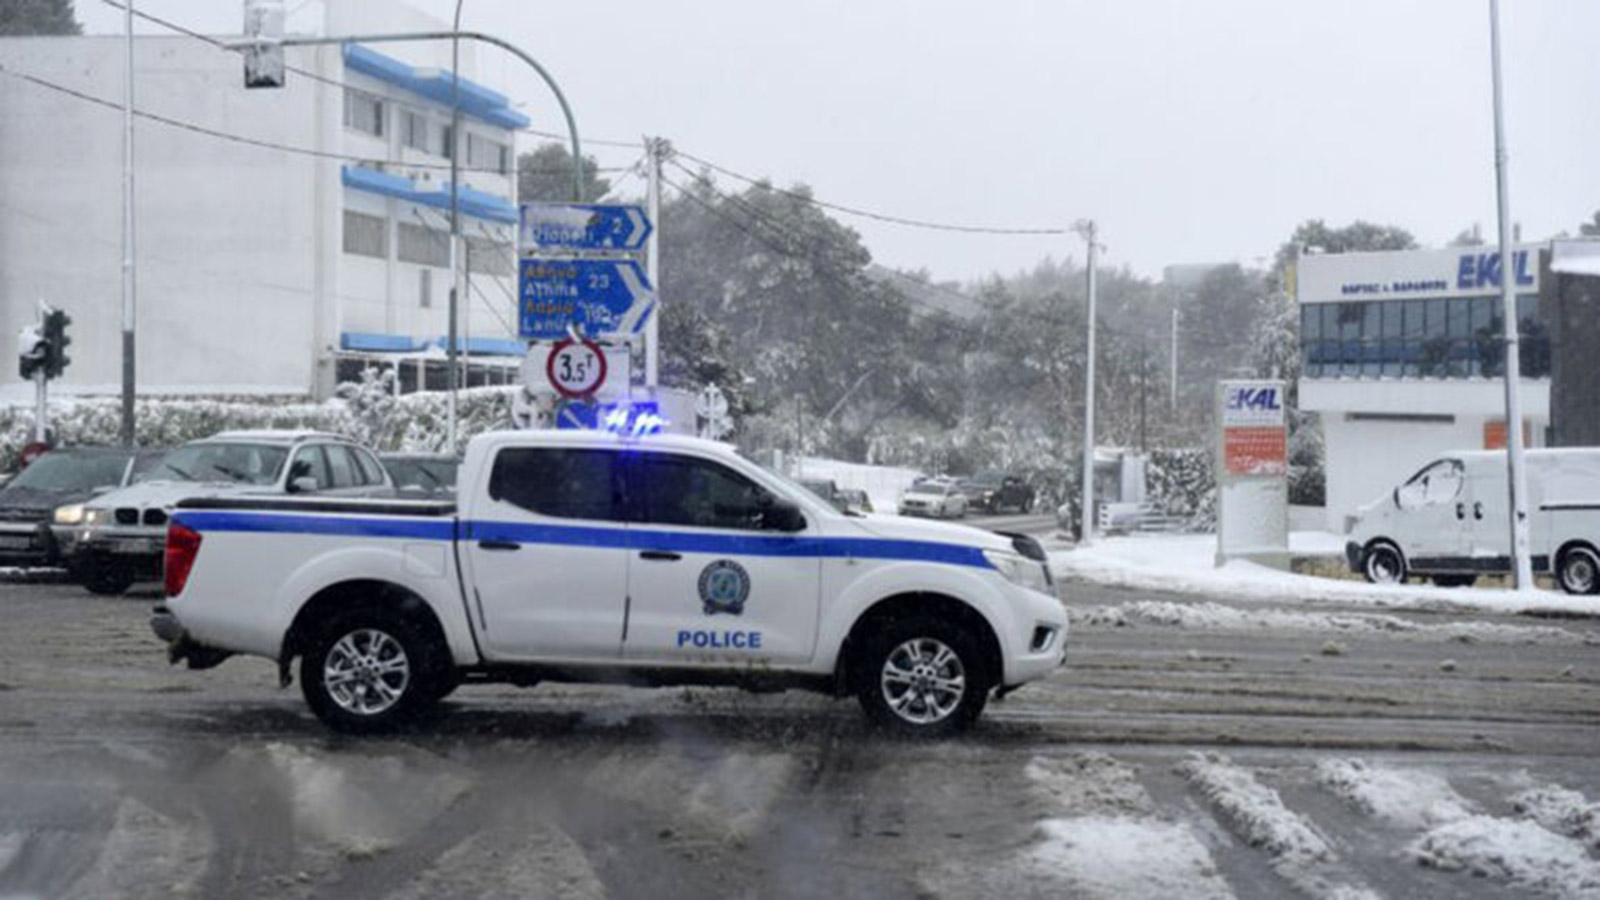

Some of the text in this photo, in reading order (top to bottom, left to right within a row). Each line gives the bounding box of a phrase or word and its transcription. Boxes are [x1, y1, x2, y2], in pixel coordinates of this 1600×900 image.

[612, 217, 622, 234] 2
[589, 274, 610, 289] 23
[1226, 387, 1281, 411] EKAL
[677, 630, 762, 648] POLICE
